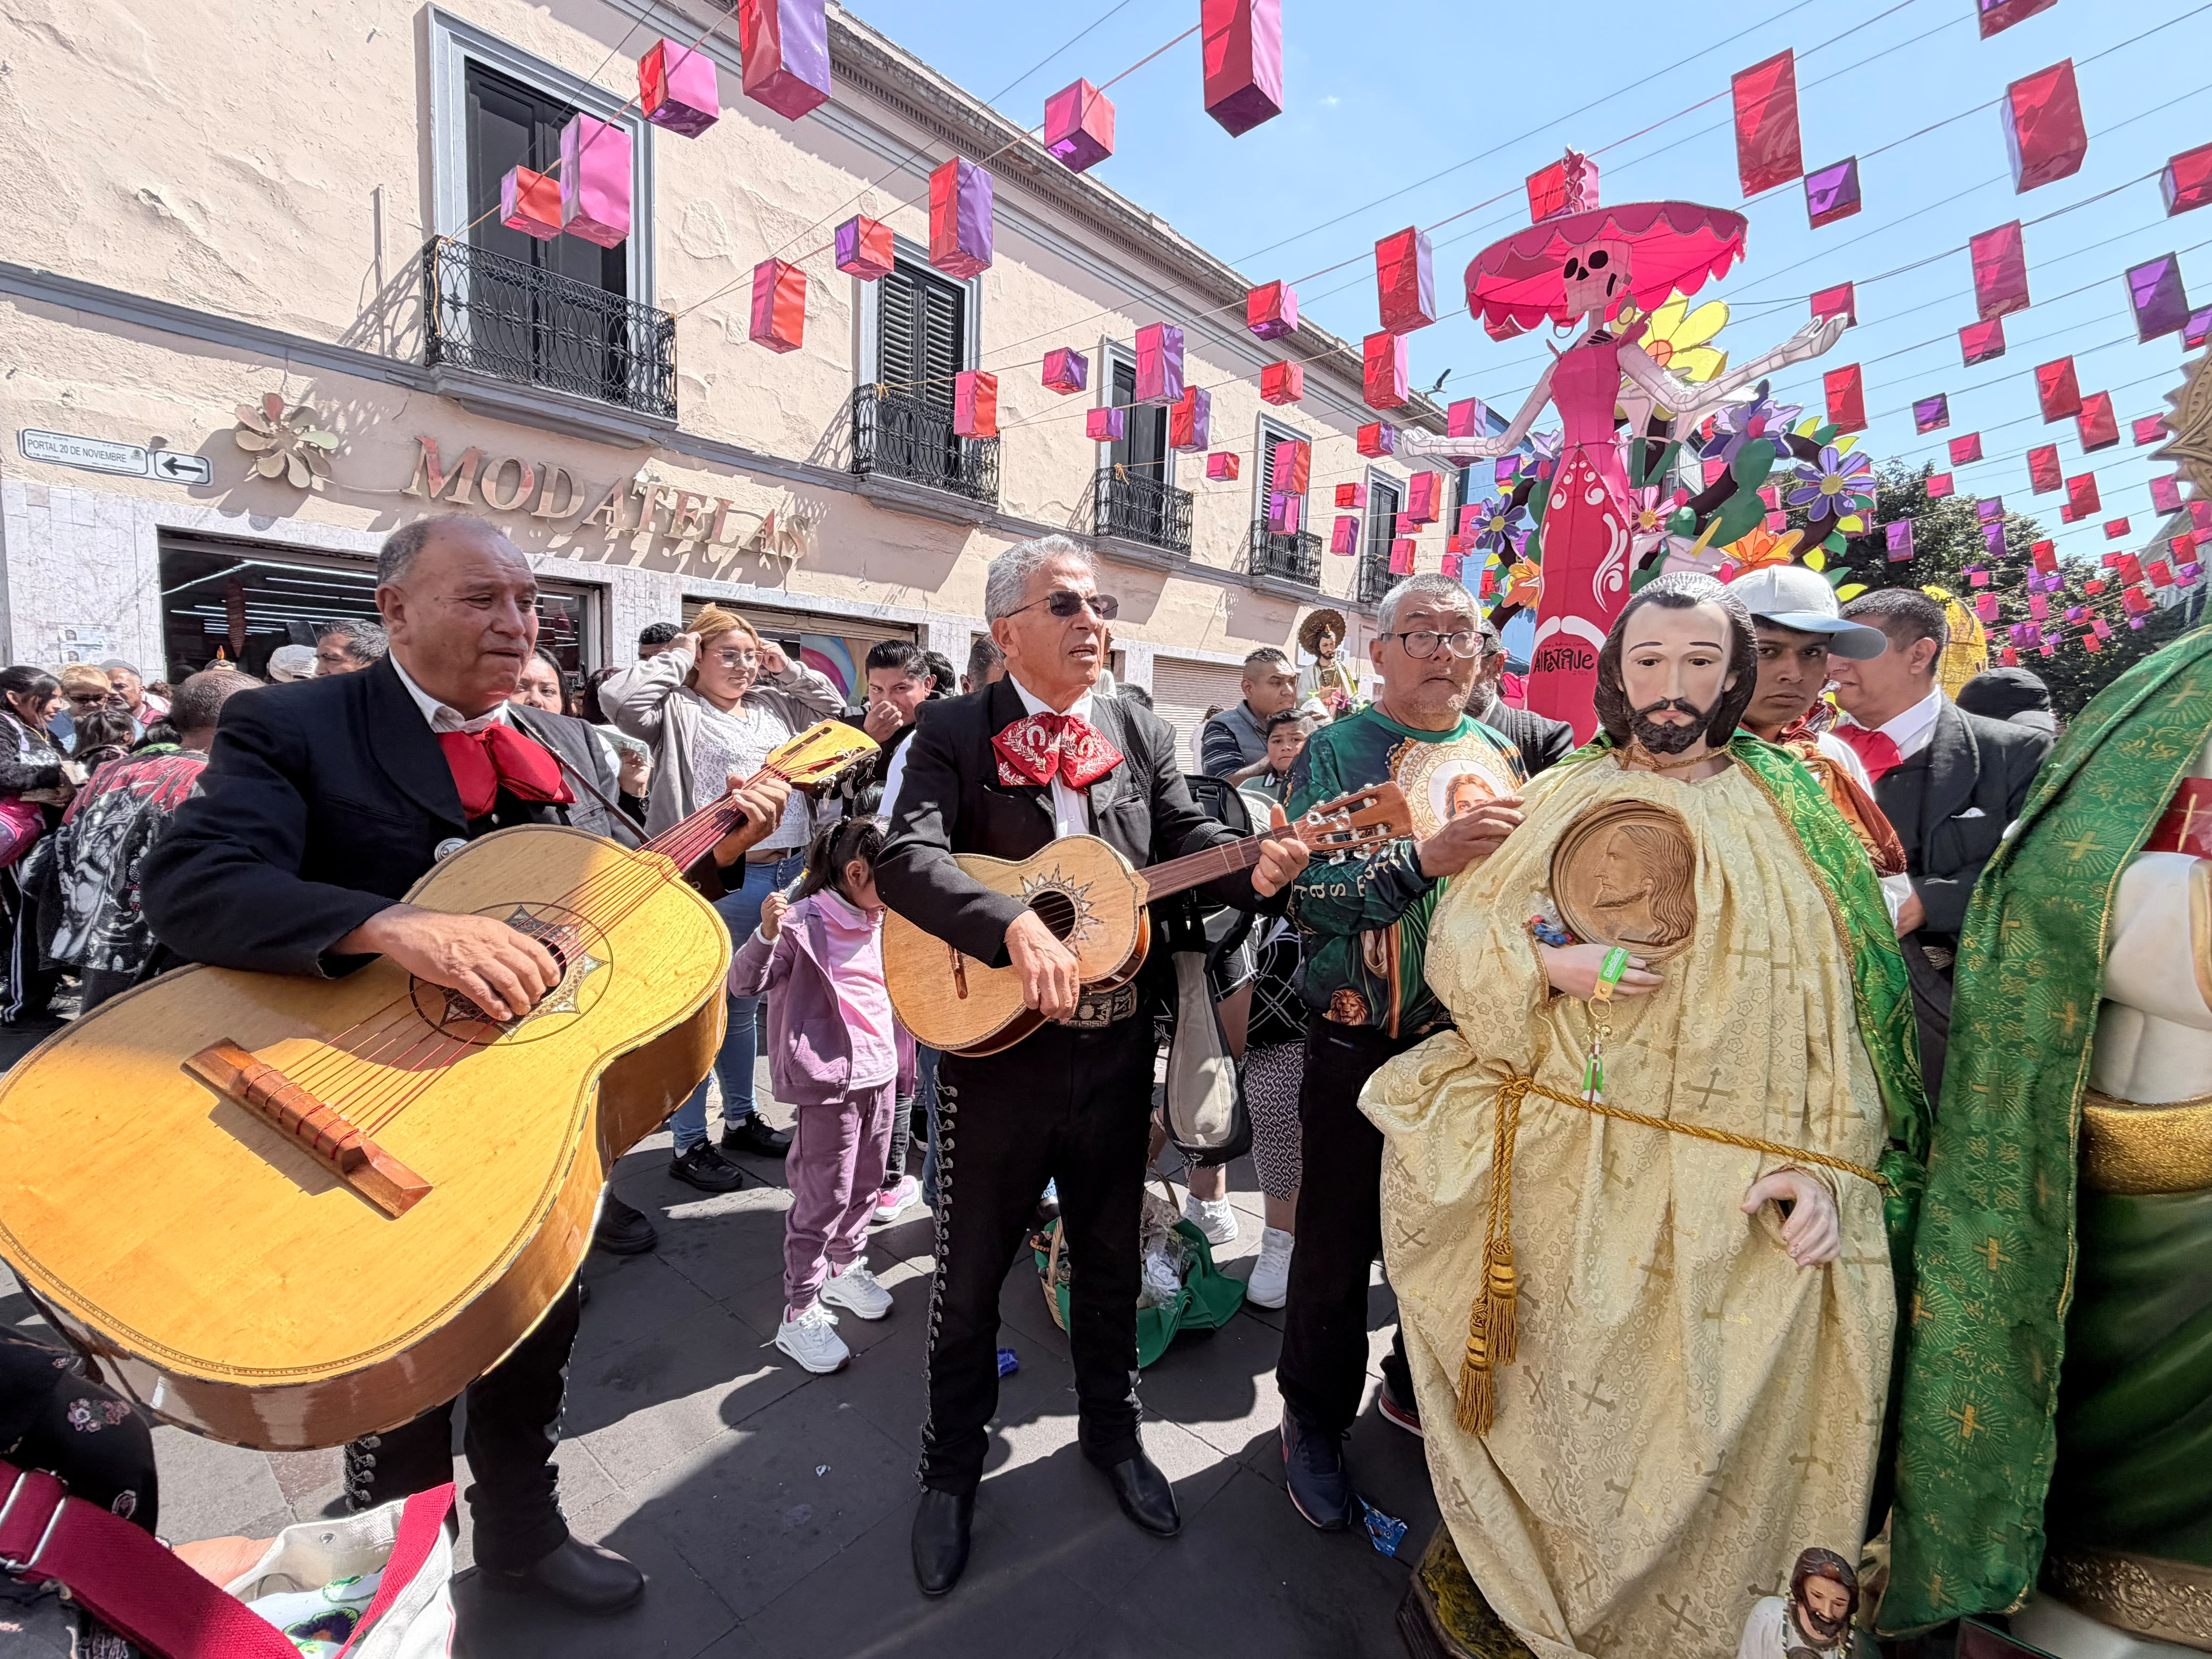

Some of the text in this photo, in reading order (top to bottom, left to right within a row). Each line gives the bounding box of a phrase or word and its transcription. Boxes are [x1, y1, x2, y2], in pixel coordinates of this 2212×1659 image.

[27, 439, 58, 452] PORTAL
[59, 444, 68, 454] 20
[70, 446, 81, 456] DE
[82, 448, 127, 463] NOVIEMBRE
[401, 436, 810, 560] MODATELAS
